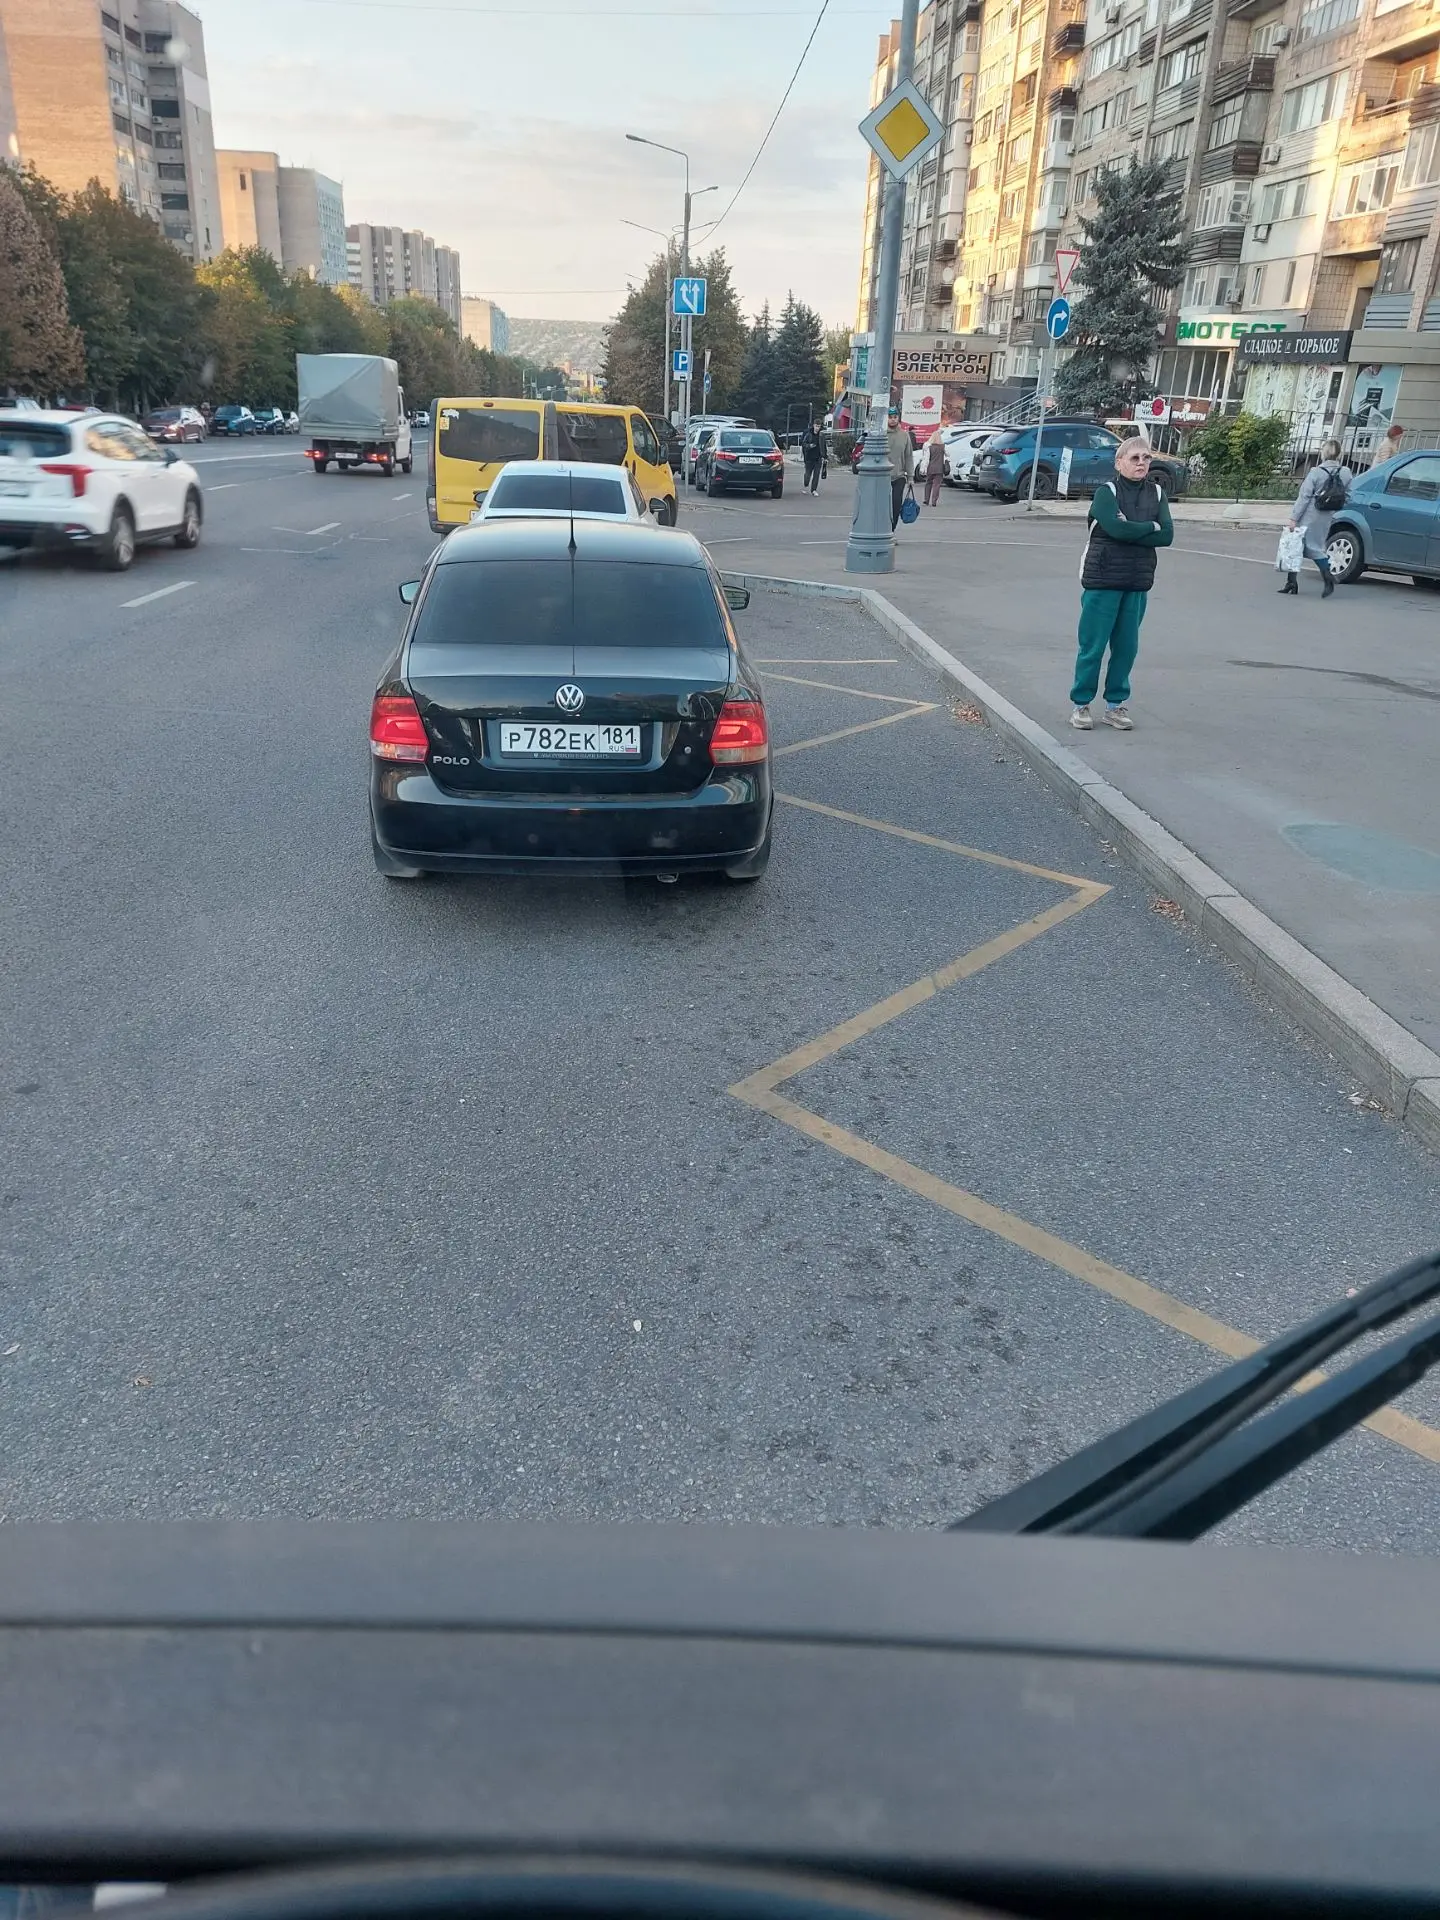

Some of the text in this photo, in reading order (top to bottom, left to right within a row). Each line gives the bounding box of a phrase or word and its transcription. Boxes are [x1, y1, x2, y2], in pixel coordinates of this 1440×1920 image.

[1244, 339, 1283, 355] СЛАДКОЕ
[1294, 338, 1340, 354] ГОРЬКОЕ
[897, 351, 988, 364] ВОЕНТОРГ
[897, 363, 987, 374] ЭЛЕКТРОН
[508, 727, 635, 751] Р782ЕК 181
[432, 755, 471, 767] POLO
